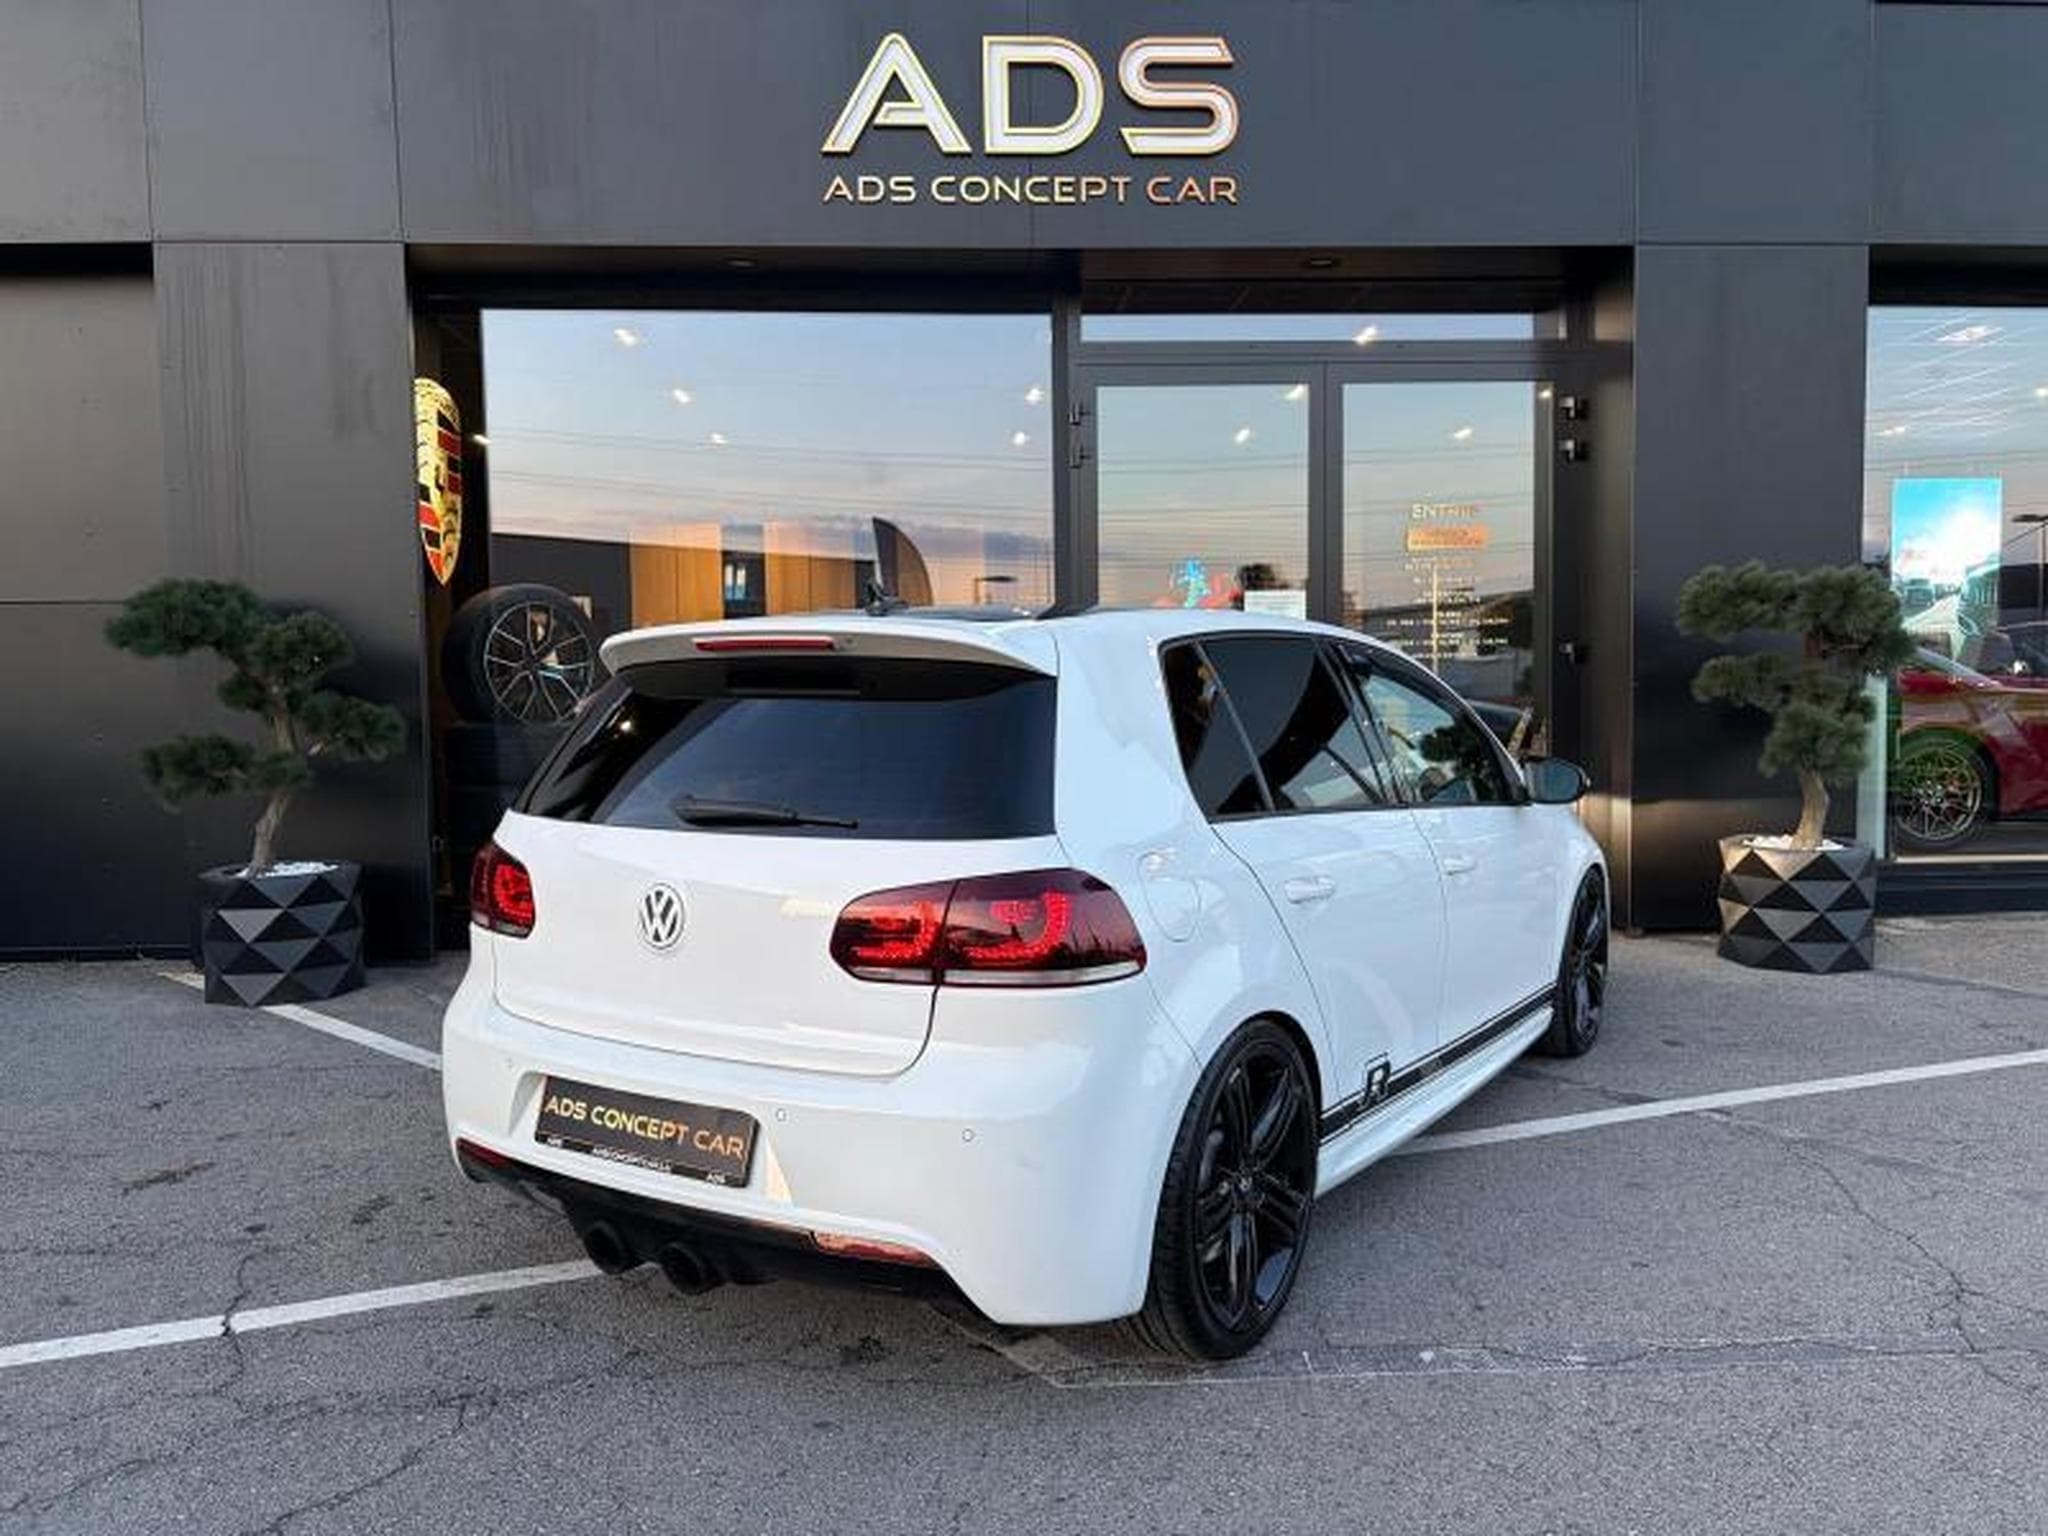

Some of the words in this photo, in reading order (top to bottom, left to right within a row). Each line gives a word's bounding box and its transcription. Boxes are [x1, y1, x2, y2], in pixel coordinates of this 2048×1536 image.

[821, 32, 1240, 156] ADS
[822, 175, 917, 203] ADS
[931, 175, 1131, 203] CONCEPT
[1146, 175, 1238, 204] CAR
[543, 1095, 588, 1121] ADS
[590, 1105, 690, 1146] CONCEPT
[693, 1129, 745, 1158] CAR
